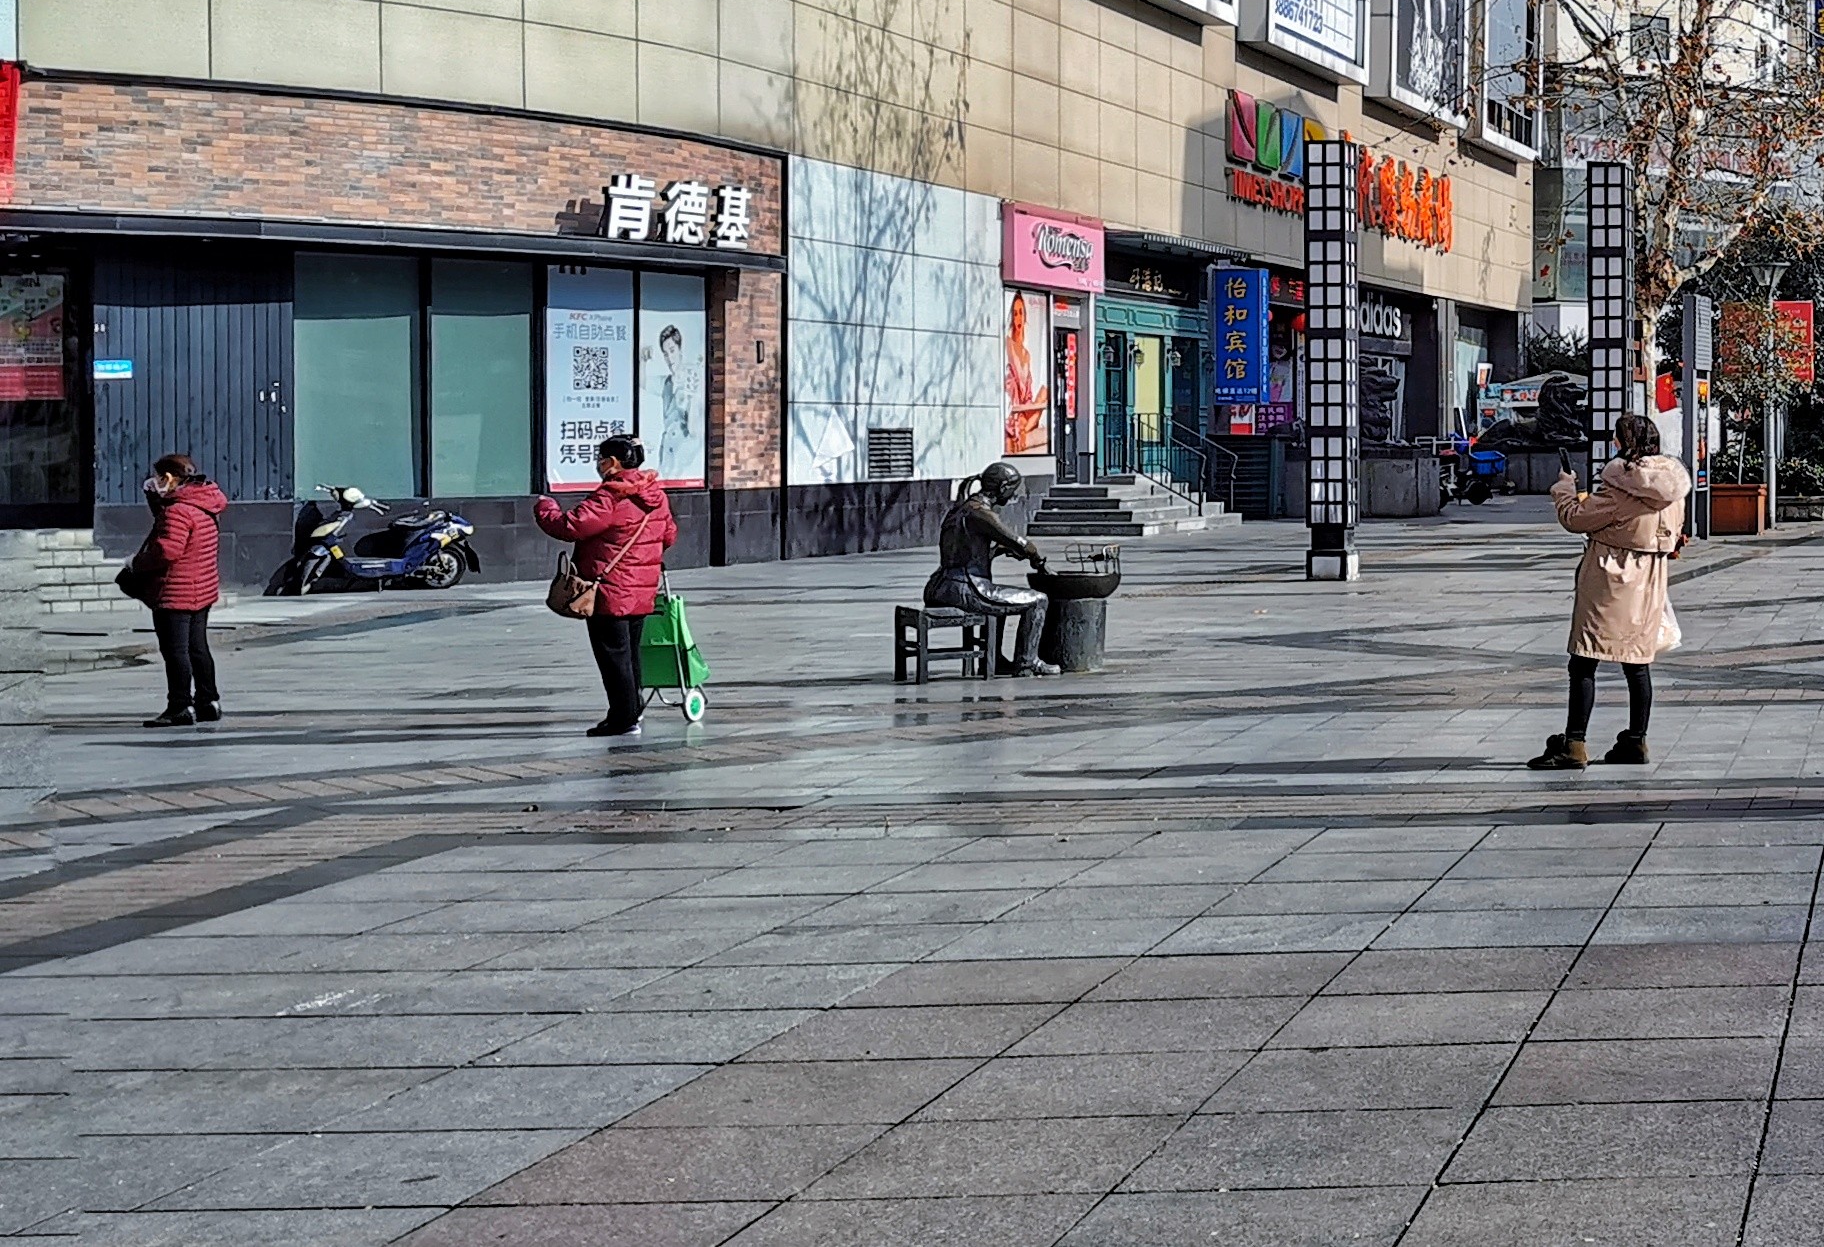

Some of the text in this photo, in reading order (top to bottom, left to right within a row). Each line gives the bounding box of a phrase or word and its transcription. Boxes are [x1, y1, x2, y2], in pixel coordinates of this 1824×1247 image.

[608, 174, 751, 250] 肯德基
[553, 322, 627, 342] 手机自助点餐
[1223, 276, 1248, 381] 怡和宾馆
[1359, 291, 1402, 338] didas
